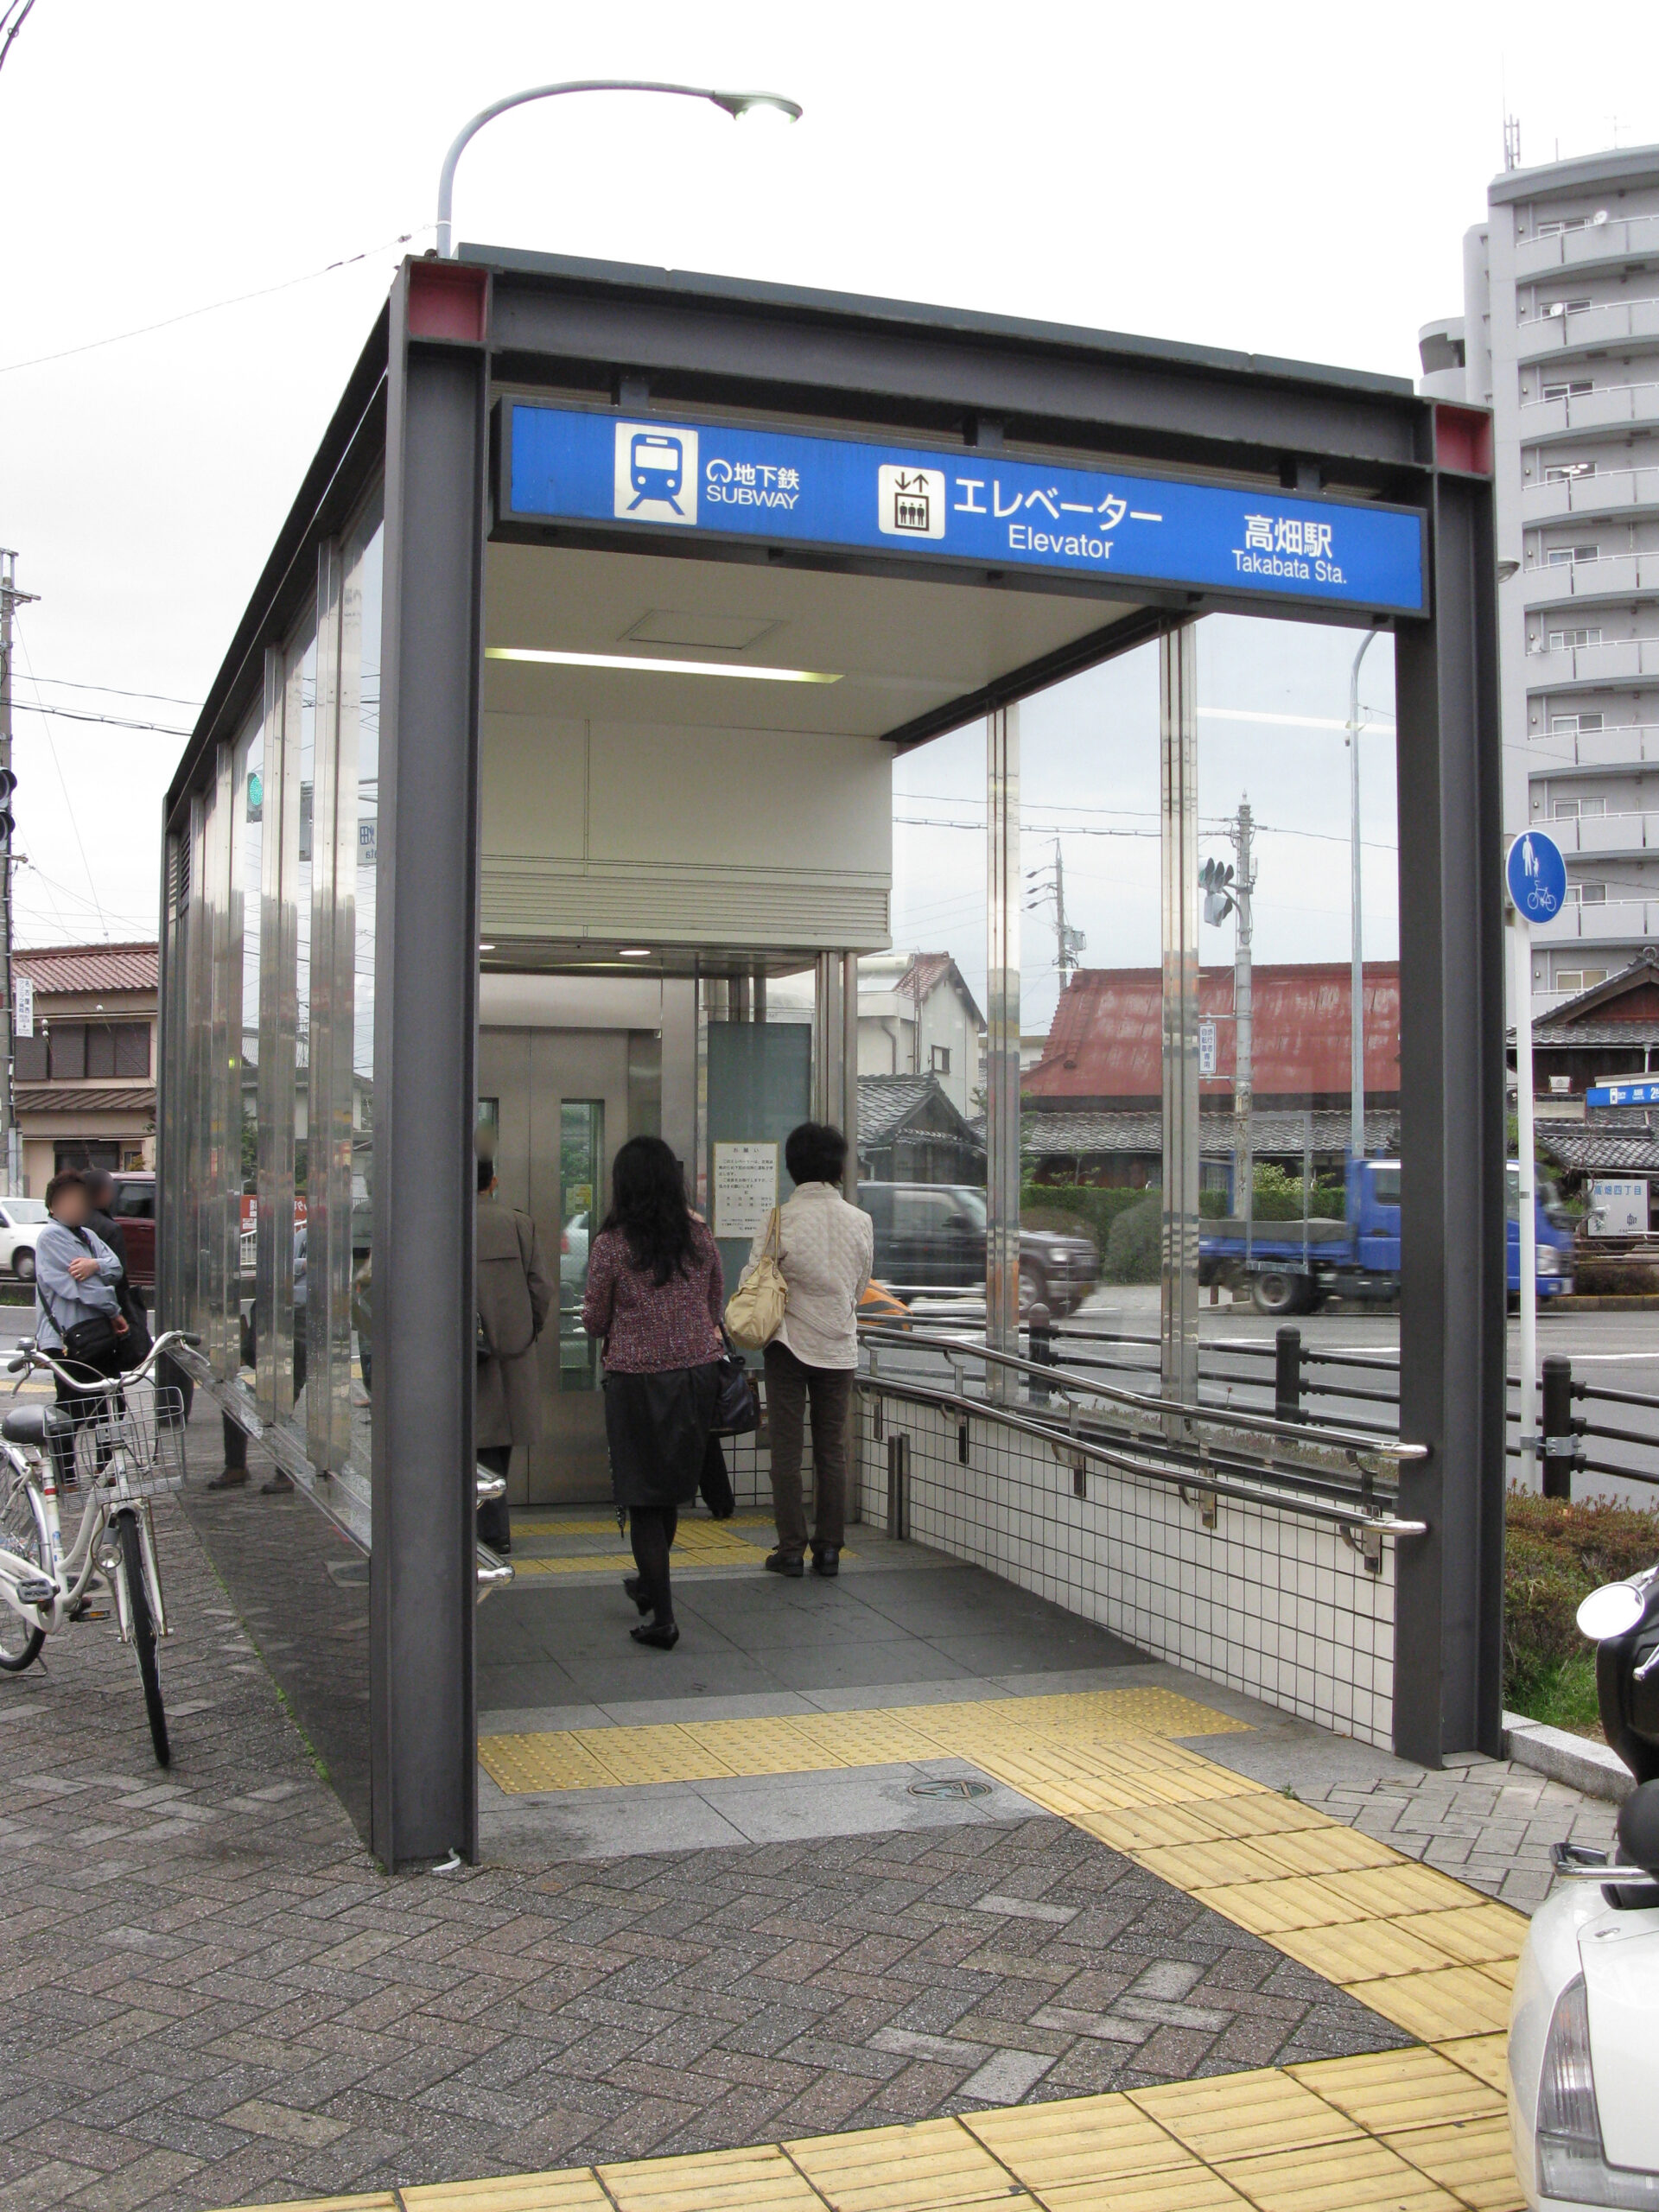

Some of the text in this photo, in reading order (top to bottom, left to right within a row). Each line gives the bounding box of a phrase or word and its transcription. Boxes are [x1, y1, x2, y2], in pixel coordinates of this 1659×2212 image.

[734, 462, 800, 491] 地下鉄
[706, 485, 800, 510] SUBWAY
[953, 478, 1163, 531] エレベーター
[1008, 524, 1115, 559] Elevator
[1244, 514, 1333, 559] 高畑駅
[1231, 550, 1347, 584] Takabata Sta.
